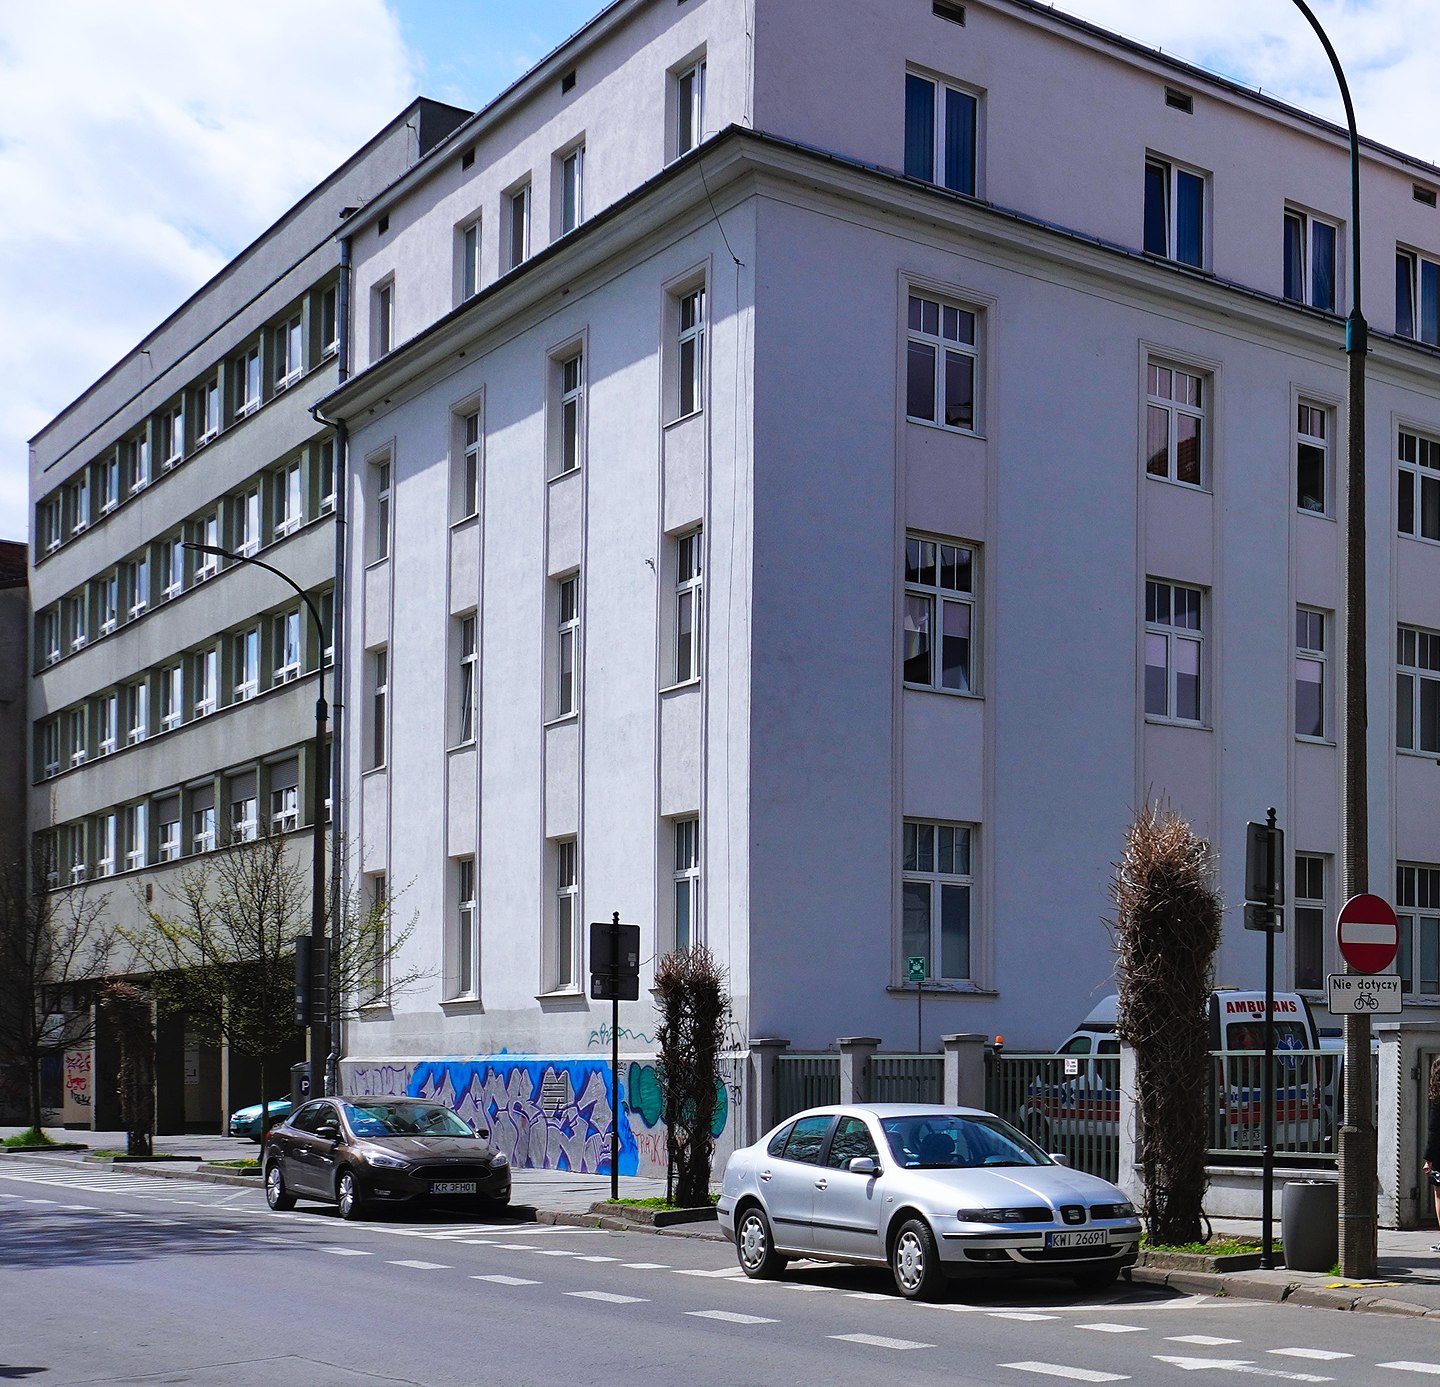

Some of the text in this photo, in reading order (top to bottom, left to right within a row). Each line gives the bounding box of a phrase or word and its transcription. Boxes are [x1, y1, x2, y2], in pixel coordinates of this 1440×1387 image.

[1333, 979, 1398, 992] Nie dotyczy
[1226, 1000, 1297, 1014] AMBUANS
[301, 1080, 310, 1091] P
[435, 1183, 448, 1192] KR
[1053, 1231, 1105, 1247] KWI 26691
